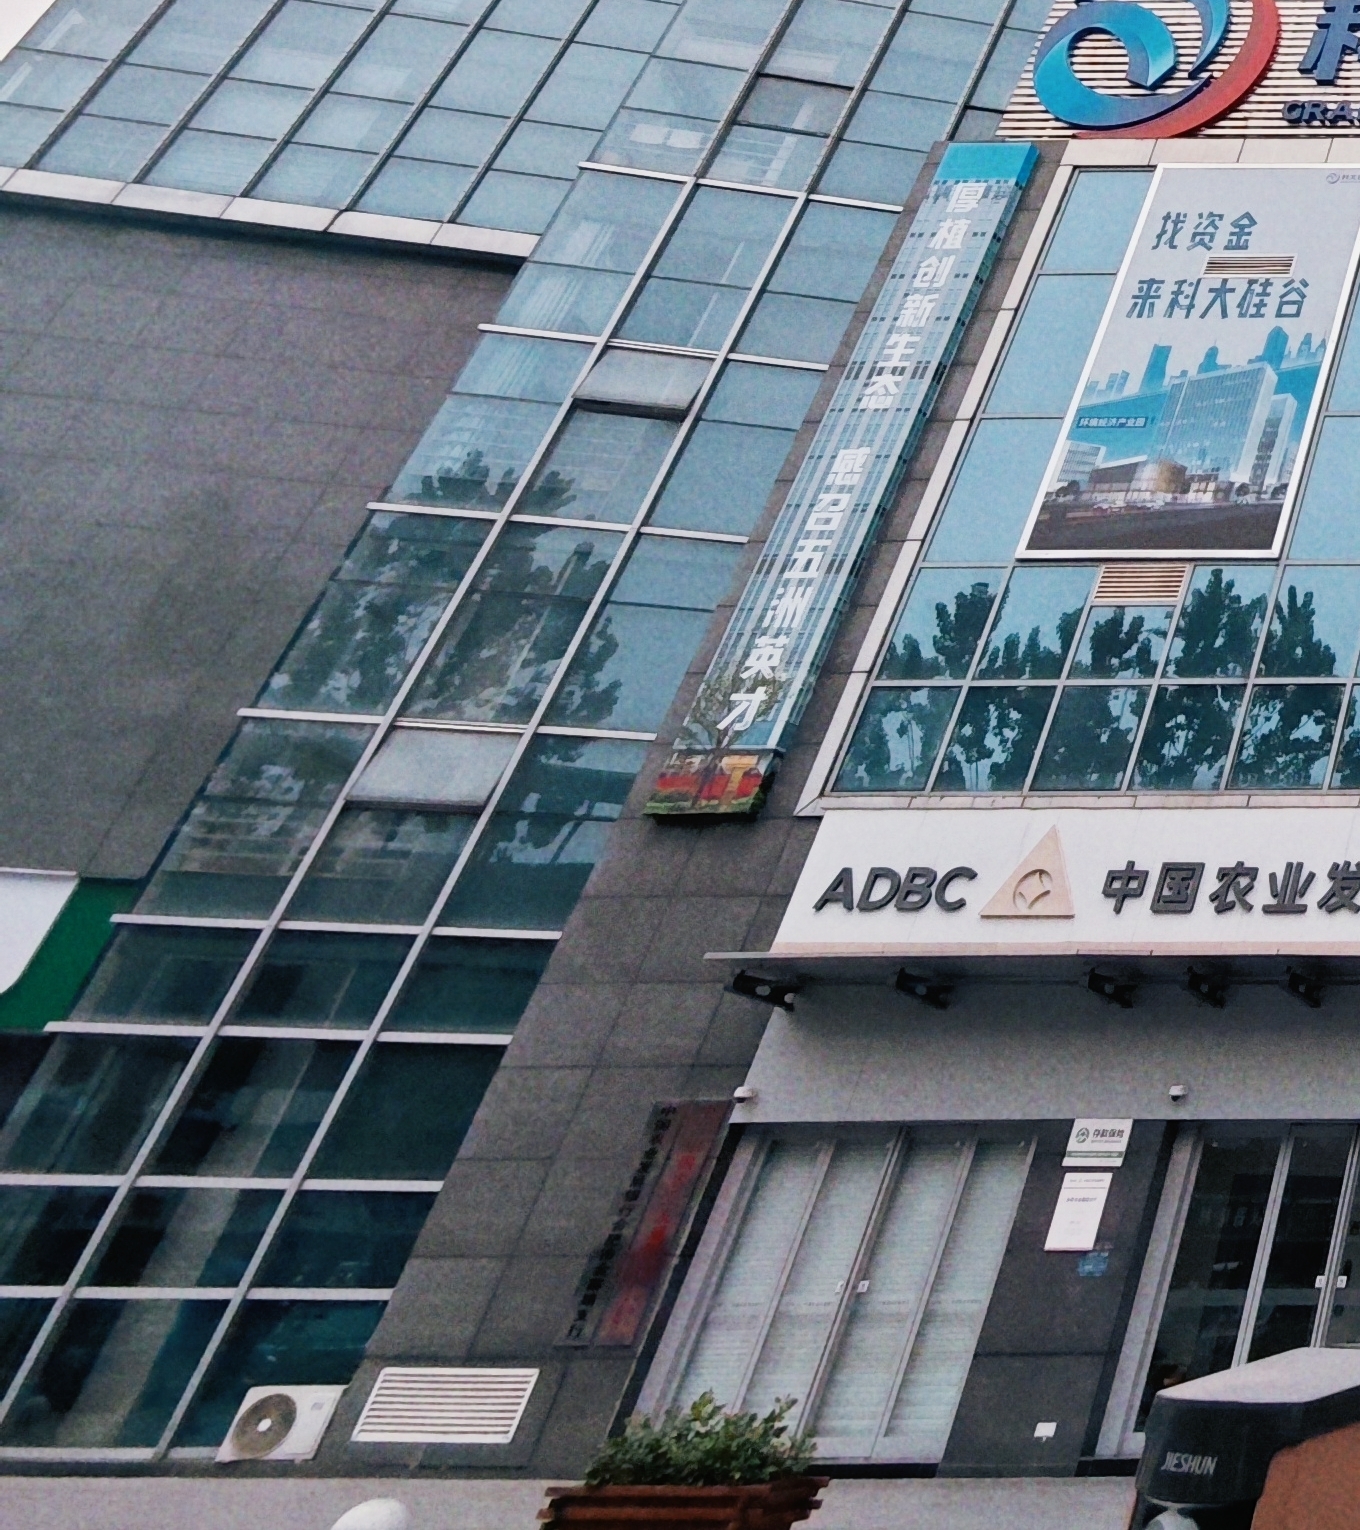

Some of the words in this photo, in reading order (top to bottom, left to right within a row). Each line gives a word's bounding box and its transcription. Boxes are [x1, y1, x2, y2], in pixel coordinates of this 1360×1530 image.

[1150, 211, 1258, 253] 找资金
[861, 181, 988, 408] 厚植创新生态
[1126, 276, 1309, 321] 来科大硅谷
[717, 446, 872, 732] 感召五洲英才
[814, 865, 979, 913] ADBC
[1161, 1451, 1218, 1475] JIESHUN
